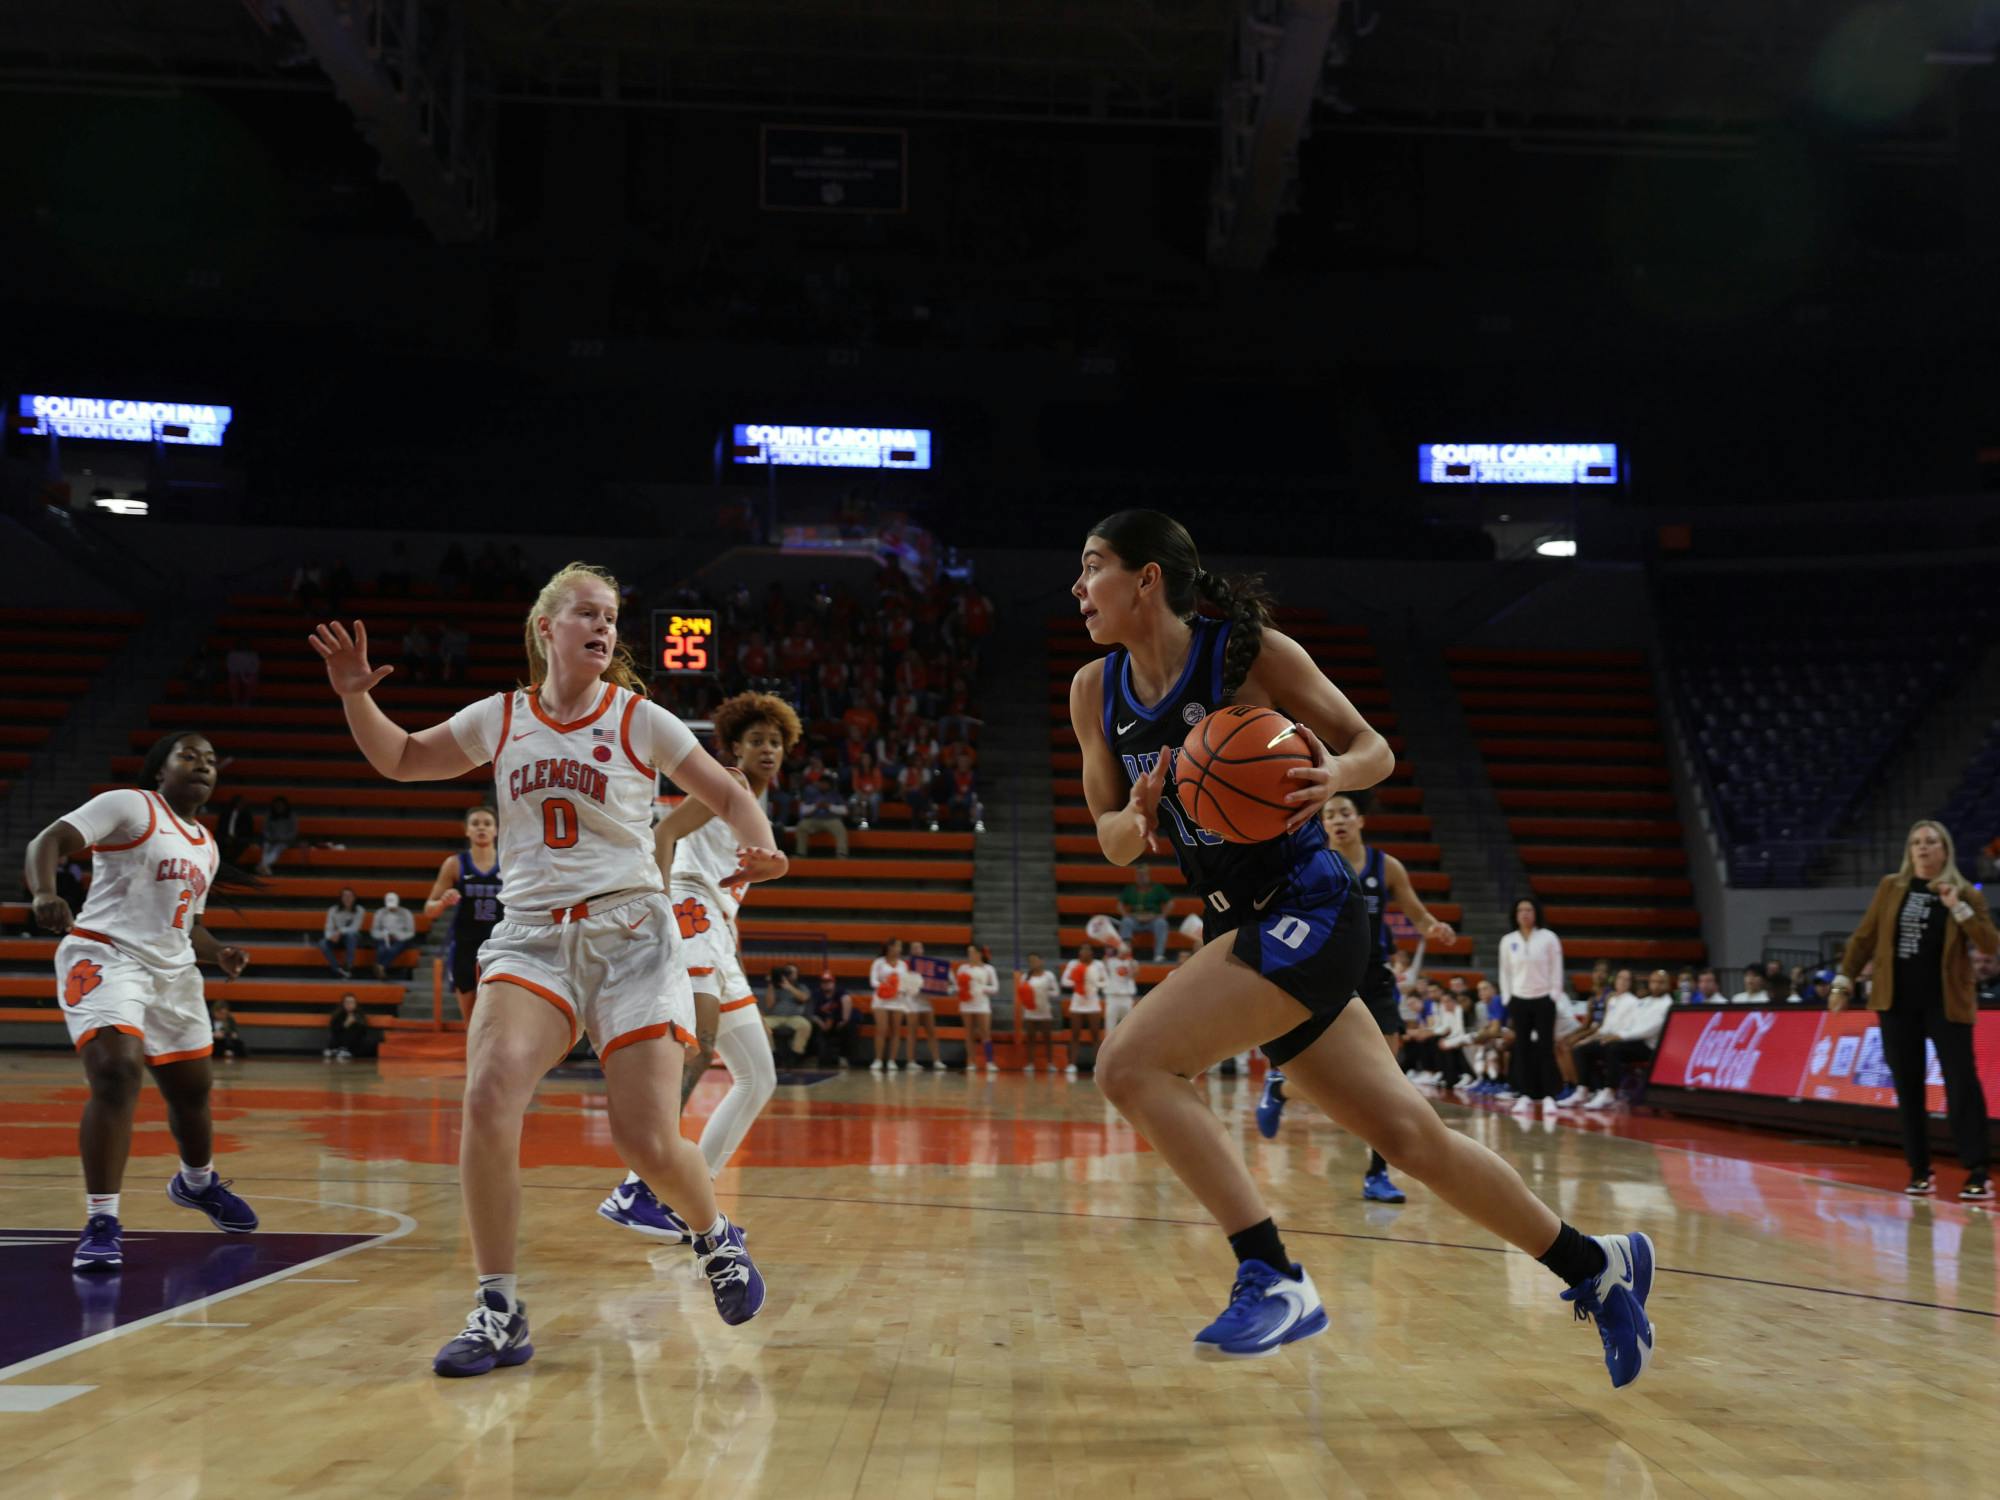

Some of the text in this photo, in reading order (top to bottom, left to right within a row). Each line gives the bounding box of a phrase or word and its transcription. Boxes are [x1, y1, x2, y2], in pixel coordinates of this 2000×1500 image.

[33, 395, 216, 424] SOUTH CAROLINA
[746, 425, 916, 449] SOUTH CAROLINA
[1431, 444, 1603, 465] SOUTH CAROLINA
[669, 616, 712, 636] 2:44
[664, 635, 707, 669] 25
[509, 758, 609, 805] CLEMSON
[541, 797, 579, 849] 0
[171, 889, 192, 929] 2
[1266, 913, 1311, 950] D
